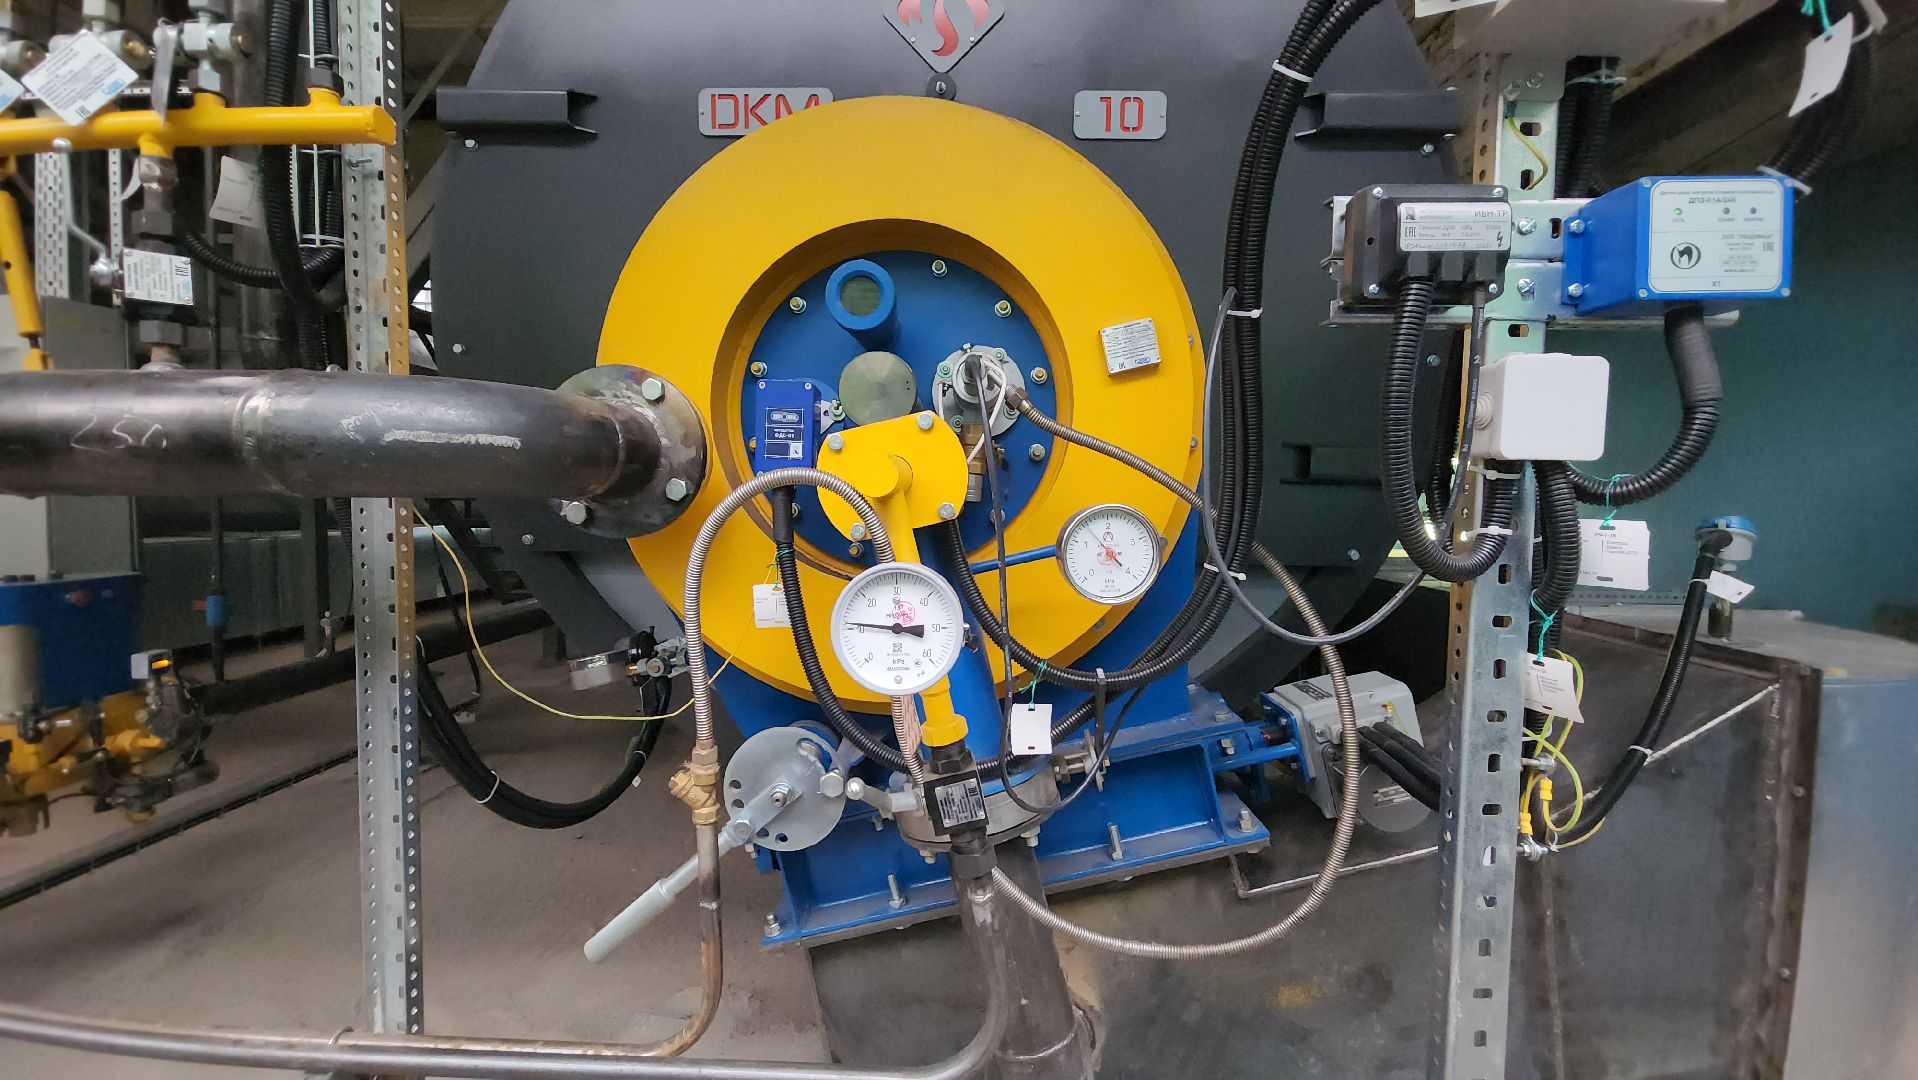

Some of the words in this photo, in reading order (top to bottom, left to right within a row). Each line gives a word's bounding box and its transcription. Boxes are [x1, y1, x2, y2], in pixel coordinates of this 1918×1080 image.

[1100, 97, 1144, 132] 10
[1105, 522, 1111, 530] 2
[1083, 541, 1088, 549] 1
[1130, 538, 1136, 546] 3
[1088, 568, 1095, 576] 0
[893, 586, 901, 596] 30
[867, 598, 877, 607] 20
[919, 597, 929, 606] 40
[931, 624, 941, 632] 50
[868, 652, 874, 660] 0
[922, 648, 932, 658] 60
